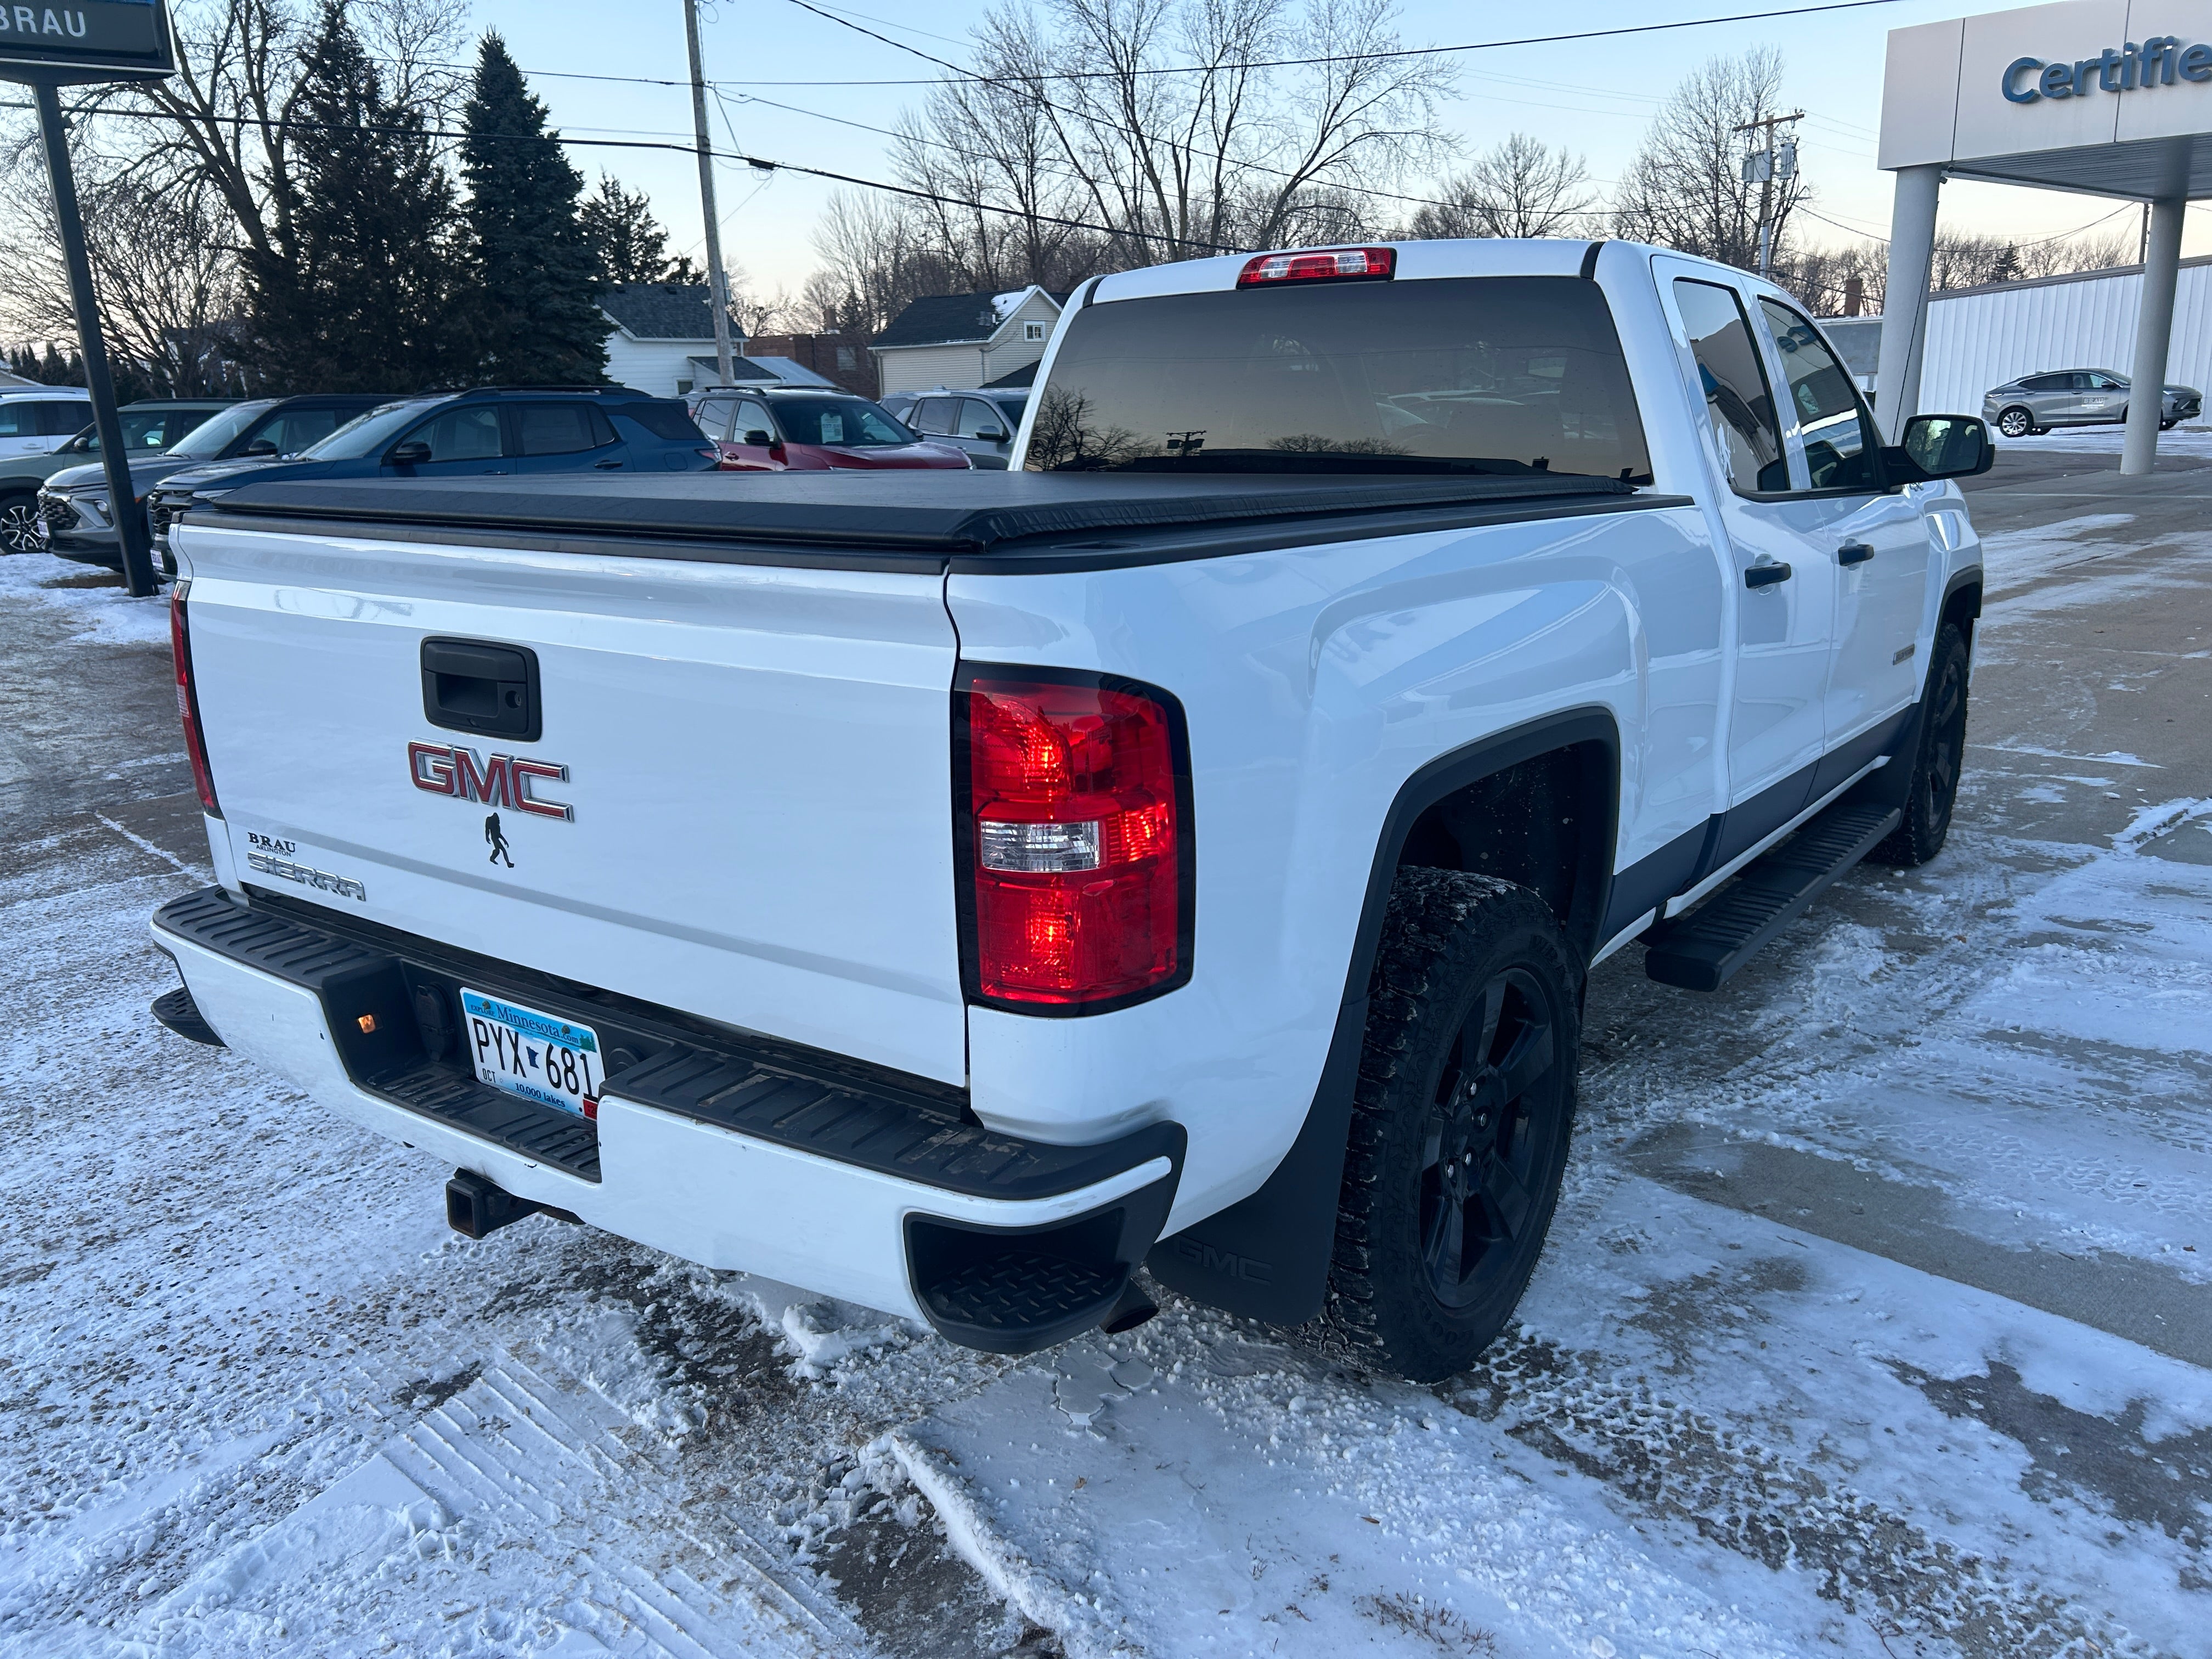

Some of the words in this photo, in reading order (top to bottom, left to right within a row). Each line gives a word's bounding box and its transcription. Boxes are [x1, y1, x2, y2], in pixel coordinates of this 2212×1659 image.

[2002, 36, 2212, 104] Certifie
[407, 738, 575, 823] GMC
[247, 832, 296, 853] BRAU
[256, 844, 291, 857] ARLINGTON
[247, 850, 366, 902] SIERRA
[472, 1017, 527, 1078] PYX
[546, 1042, 598, 1103] 681
[482, 1068, 496, 1083] OCT
[515, 1083, 541, 1098] 10,000
[544, 1092, 566, 1107] lakes
[1174, 1233, 1273, 1286] GMC
